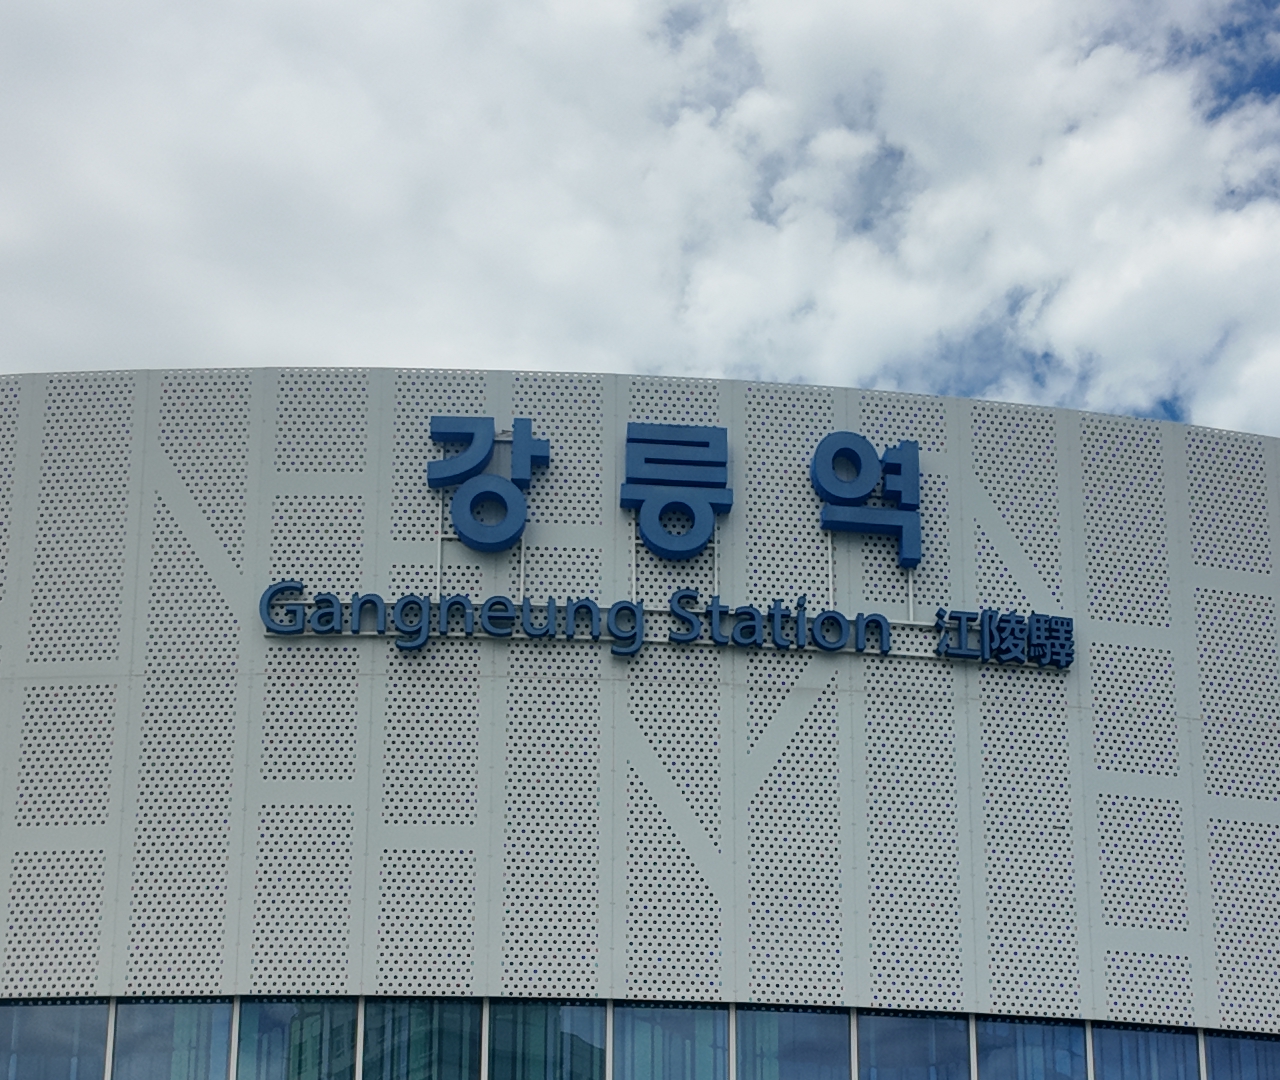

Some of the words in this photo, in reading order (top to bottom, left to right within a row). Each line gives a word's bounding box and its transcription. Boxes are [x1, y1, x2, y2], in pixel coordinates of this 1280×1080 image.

[426, 415, 921, 569] 강릉역
[259, 579, 645, 656] Gangneung
[668, 587, 891, 655] Station
[935, 606, 1075, 668] 江陵驛
